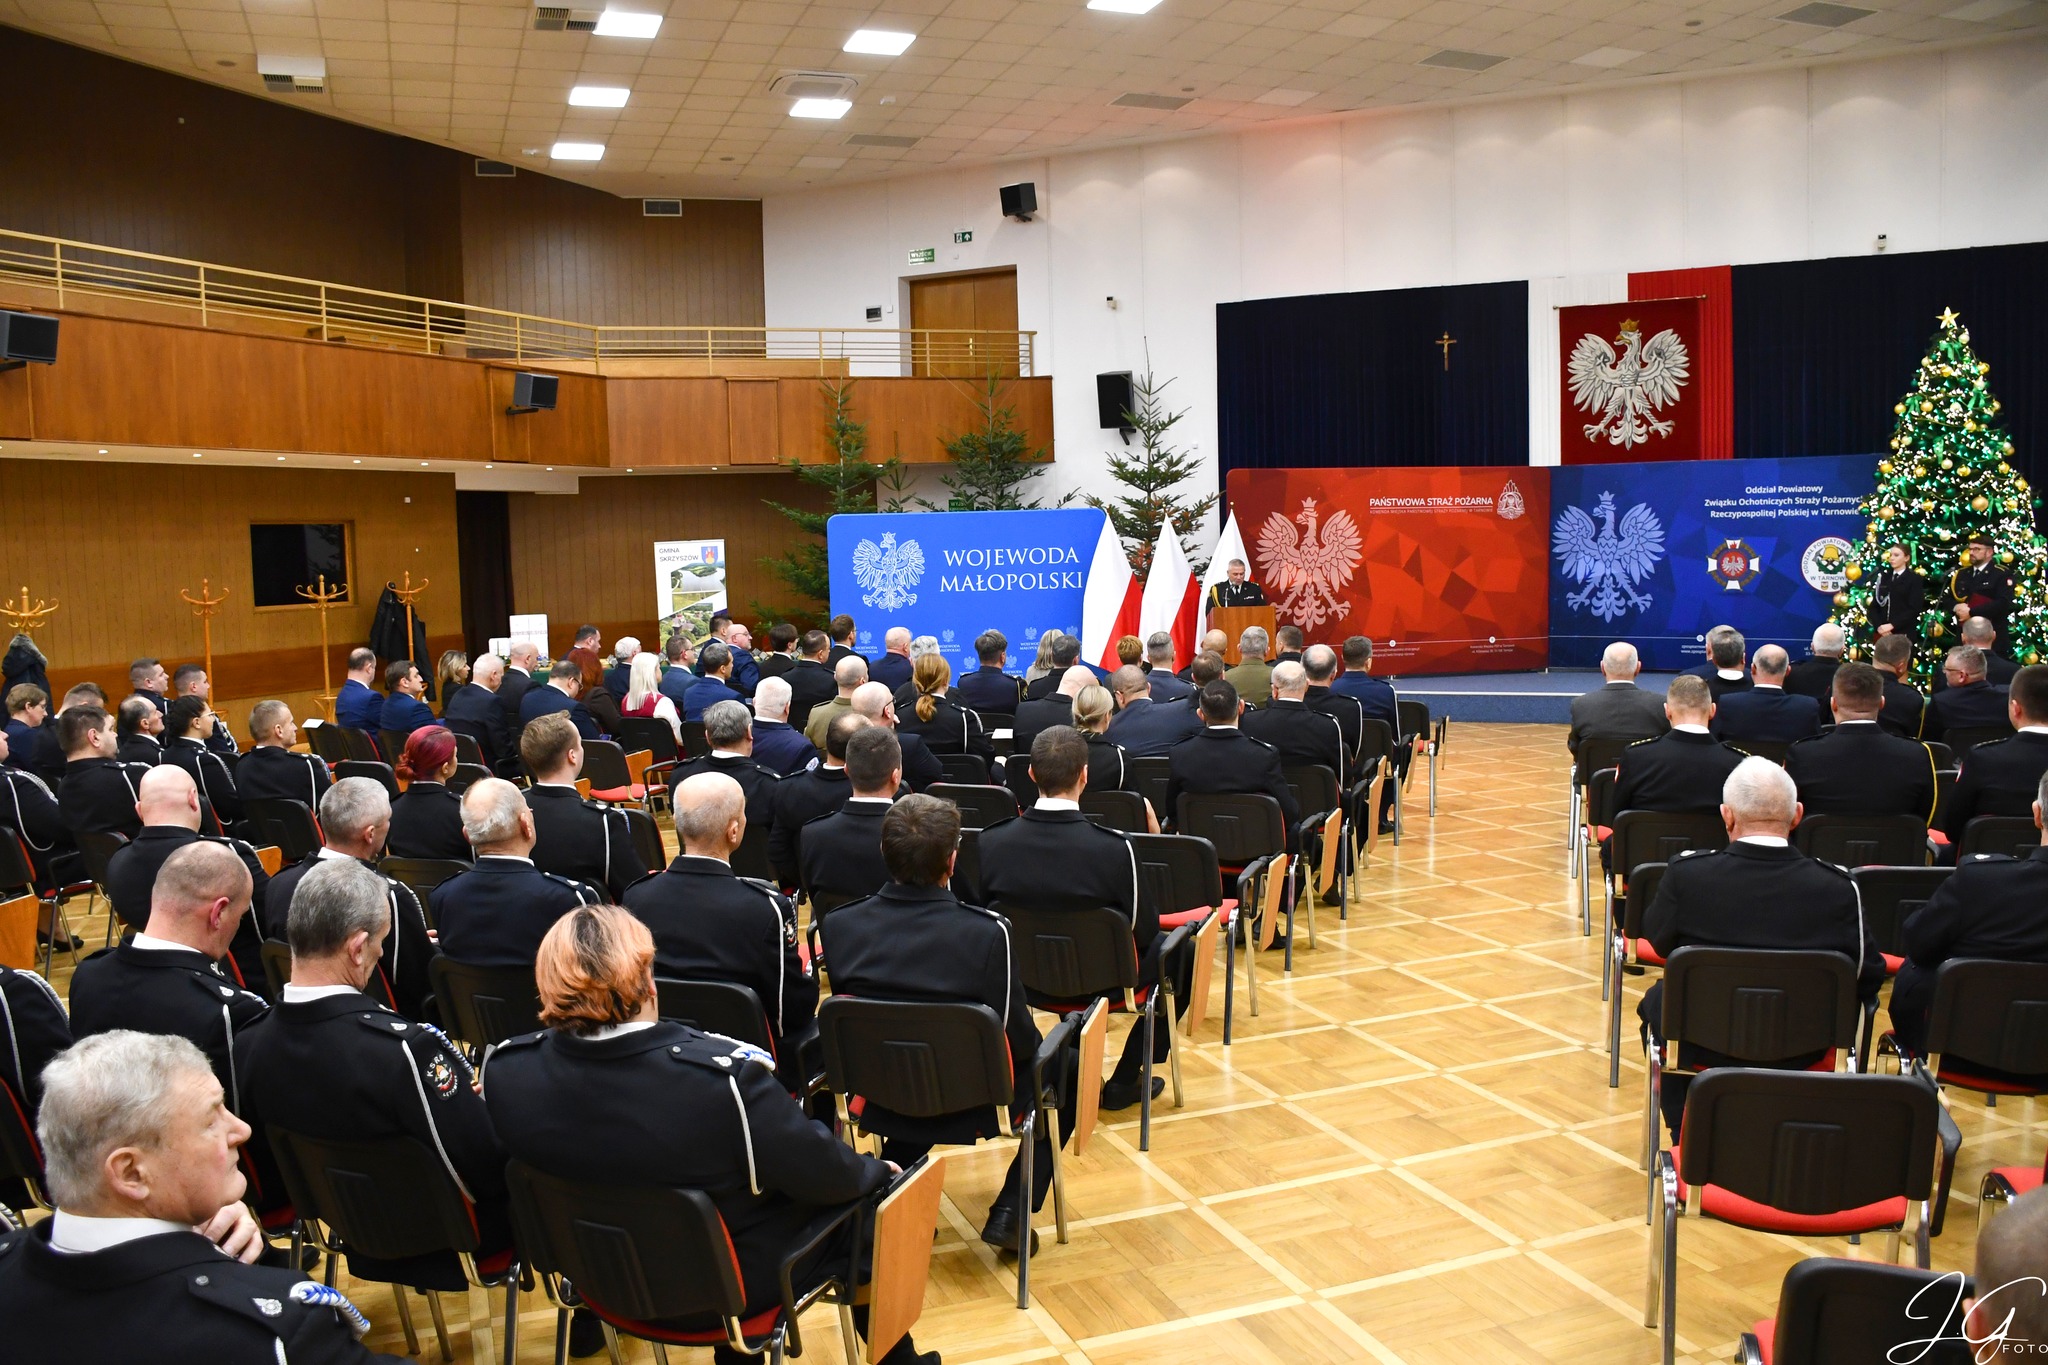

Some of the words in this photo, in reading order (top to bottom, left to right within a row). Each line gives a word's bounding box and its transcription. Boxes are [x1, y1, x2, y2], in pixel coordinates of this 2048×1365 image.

[1745, 486, 1776, 494] Oddział
[1778, 485, 1823, 494] Powiatowy
[1370, 496, 1425, 506] PAŃSTWOWA
[1427, 496, 1453, 506] STRAŻ
[1454, 495, 1493, 505] POŻARNA
[1704, 499, 1737, 507] Związku
[1739, 498, 1793, 506] Ochotniczych
[1794, 496, 1820, 505] Straży
[1710, 510, 1776, 518] Rzeczypospolitej
[1778, 509, 1809, 517] Polskiej
[1820, 508, 1859, 516] Tarnowie
[943, 546, 1080, 570] WOJEWODA
[1803, 549, 1814, 574] ODDZIAŁ
[1813, 538, 1850, 551] POWIATOWY
[940, 571, 1083, 592] MAŁOPOLSKI
